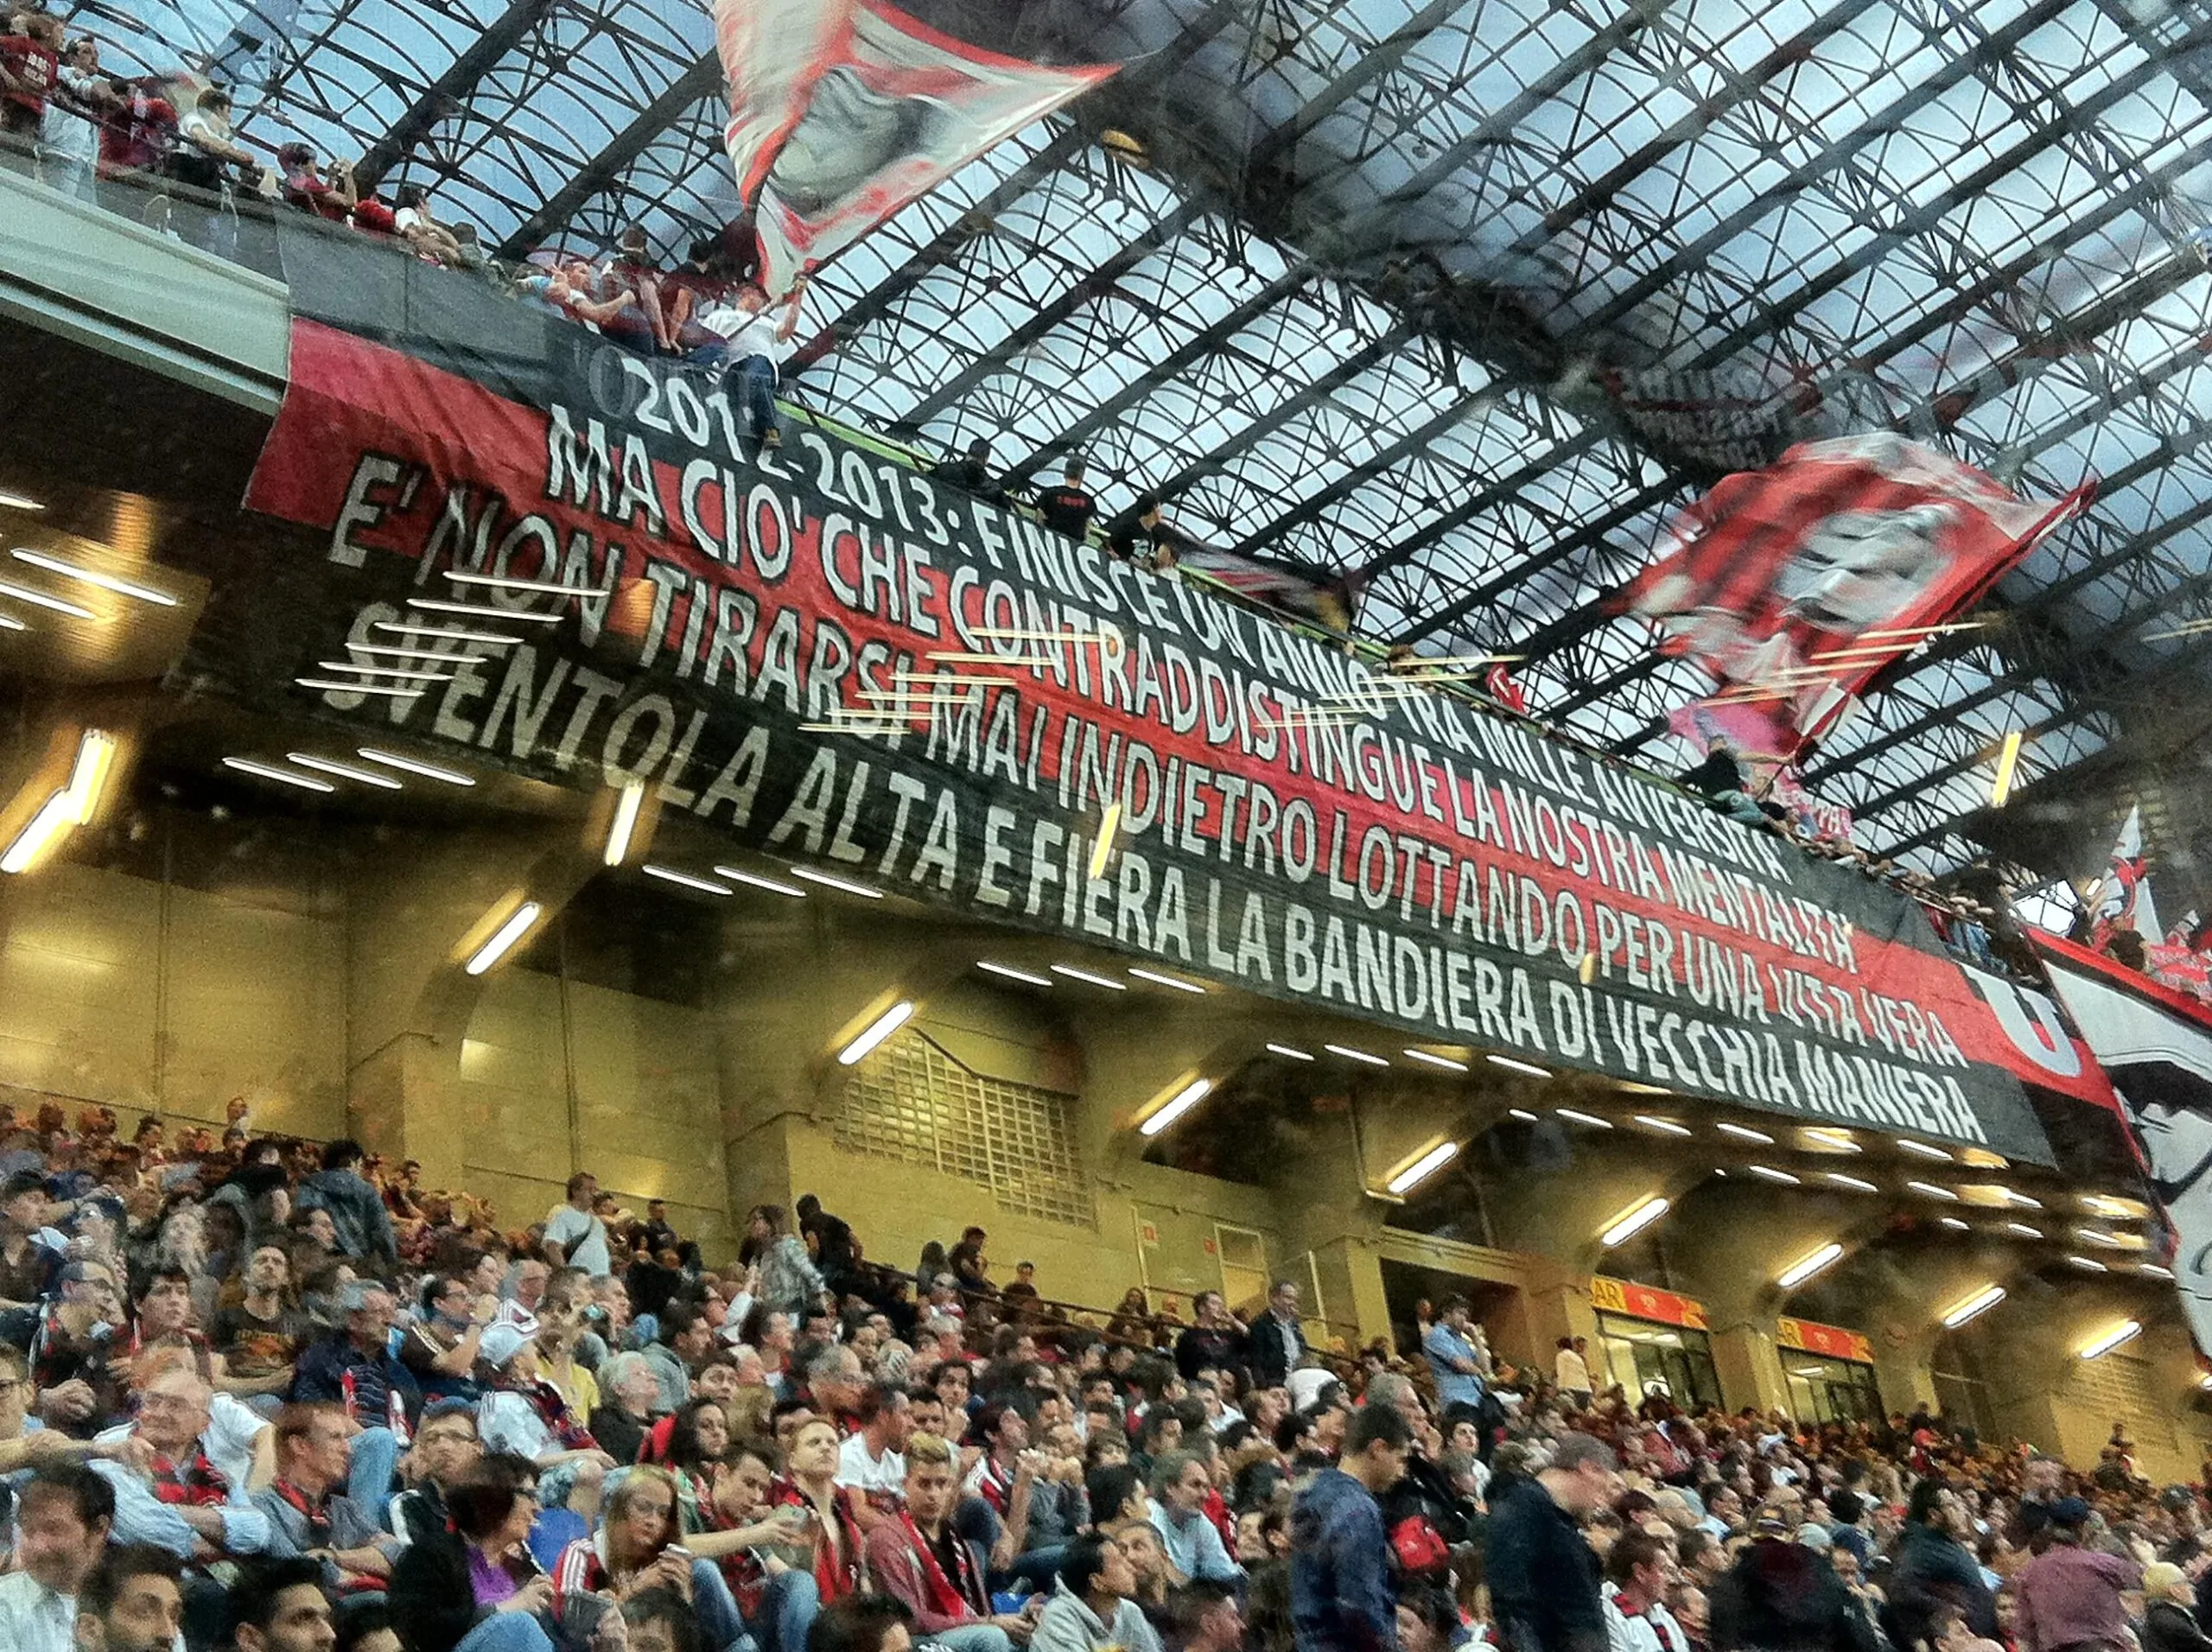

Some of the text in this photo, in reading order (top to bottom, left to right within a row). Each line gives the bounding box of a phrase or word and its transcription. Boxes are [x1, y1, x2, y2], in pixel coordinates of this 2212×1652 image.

[322, 600, 1986, 1143] SVENTOLA ALTA E FIERA LA BANDIERA DI VECCHIA MANIERA
[329, 454, 1969, 1067] E' NON TIRARSI MAI INDIETRO LOTTANDO PER UNA VITA VERA
[547, 403, 664, 534] MA
[681, 458, 804, 581] CIO'
[822, 512, 940, 637] CHE
[951, 566, 1445, 822] CONTRADDISTINGUE
[1443, 757, 1503, 848] LA
[1498, 779, 1665, 902] NOSTRA
[969, 501, 1173, 634] FINISCE
[1171, 574, 1256, 669] UN
[1255, 615, 1389, 721] ANNO
[1382, 674, 1483, 760] TRA
[1478, 710, 1598, 809] MILLE
